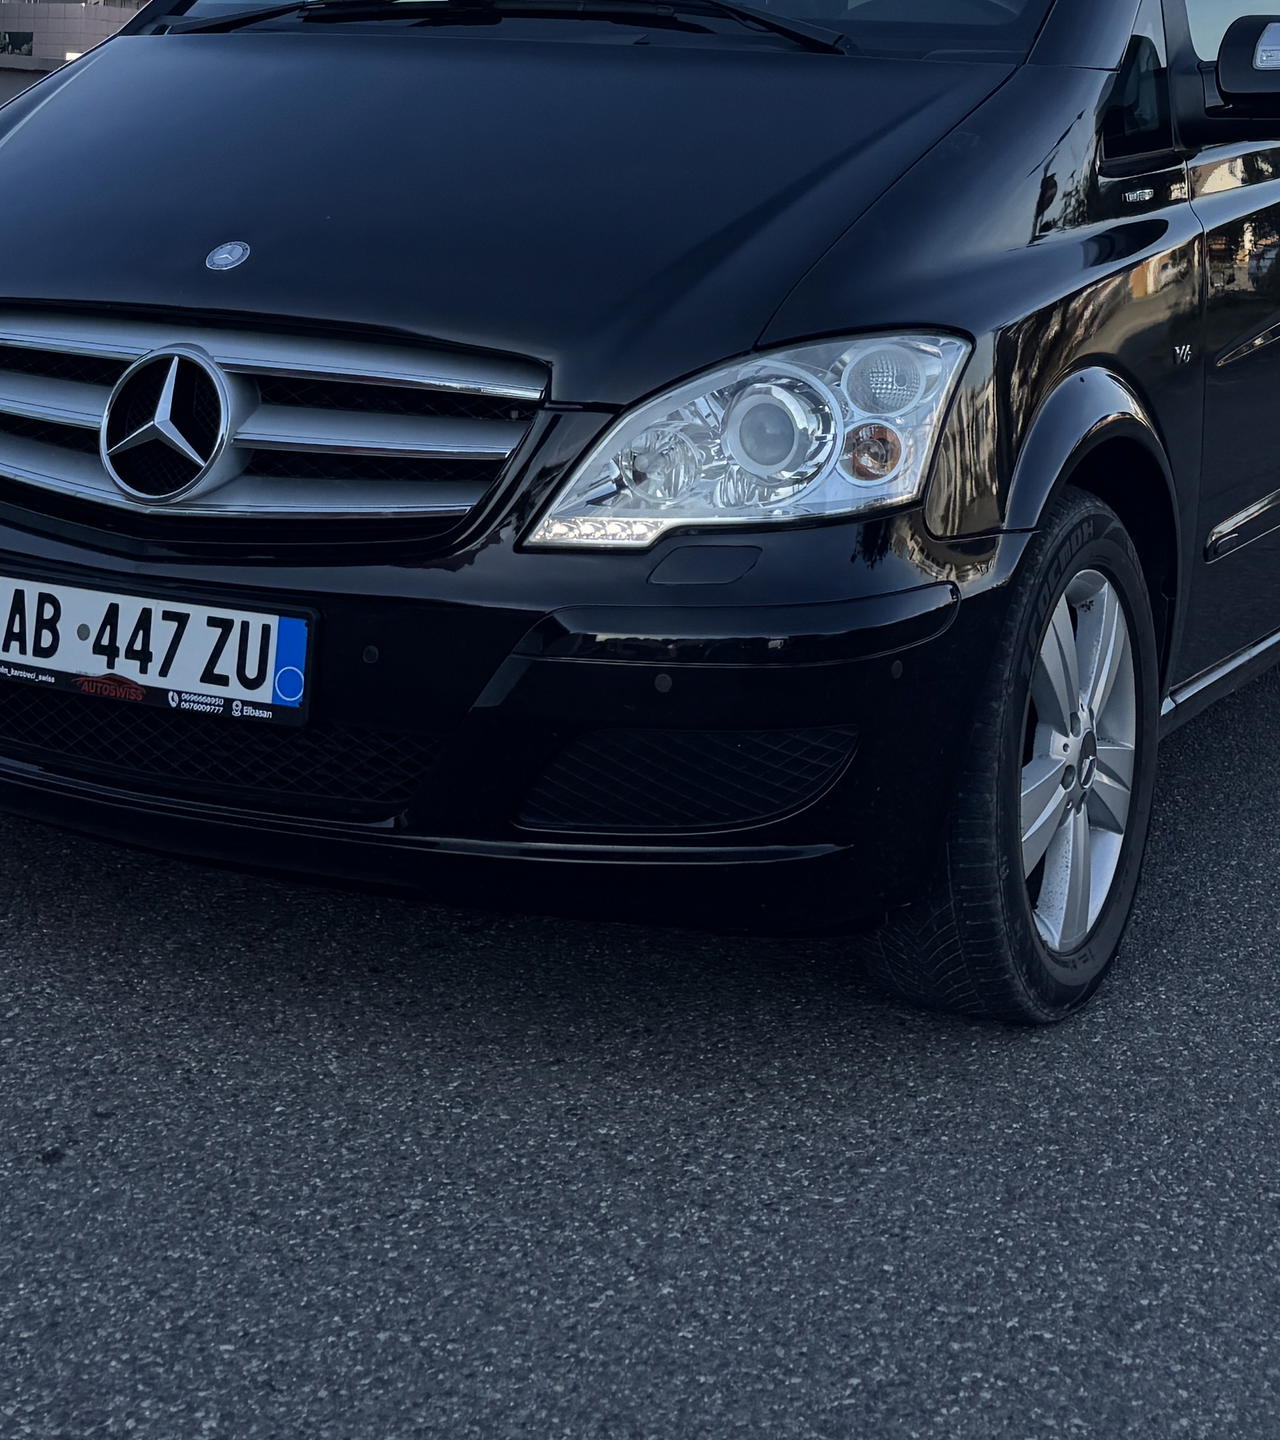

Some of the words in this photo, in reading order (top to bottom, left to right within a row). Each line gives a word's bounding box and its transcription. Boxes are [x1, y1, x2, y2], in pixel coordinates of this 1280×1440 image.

[1, 588, 62, 659] AB
[92, 602, 190, 678] 447
[199, 615, 272, 691] ZU
[80, 681, 144, 701] AUTOSWISS
[243, 706, 273, 719] Elbasan
